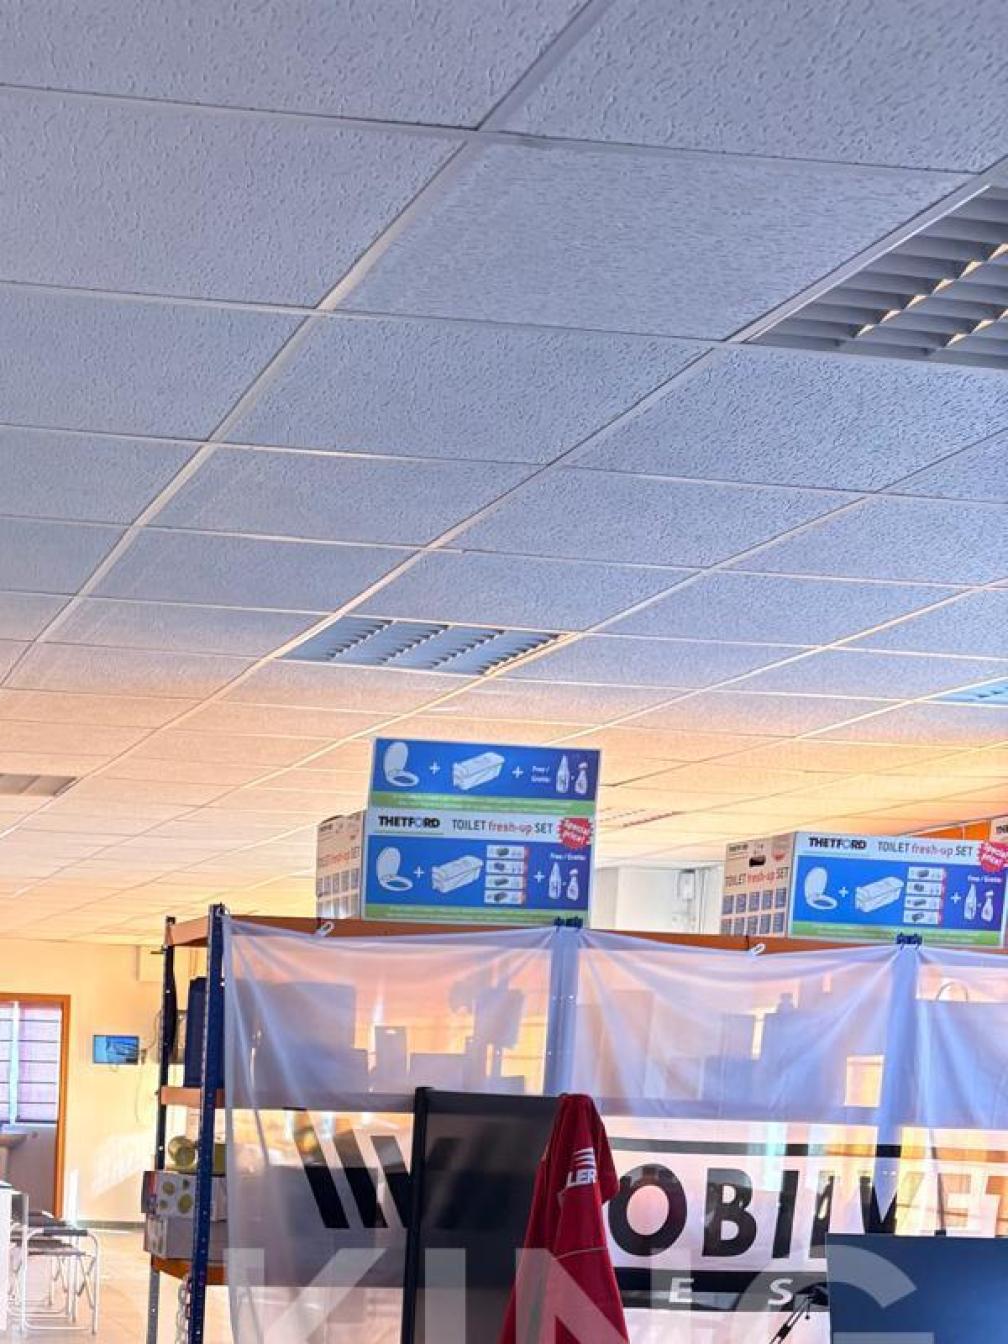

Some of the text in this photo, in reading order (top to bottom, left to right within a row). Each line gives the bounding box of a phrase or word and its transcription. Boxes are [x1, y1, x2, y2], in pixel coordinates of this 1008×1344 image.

[378, 815, 440, 829] THETFORD
[452, 819, 486, 831] TOILET
[535, 822, 553, 834] SET
[809, 837, 867, 850] THETFORD
[878, 841, 910, 853] TOILET
[955, 845, 973, 857] SET
